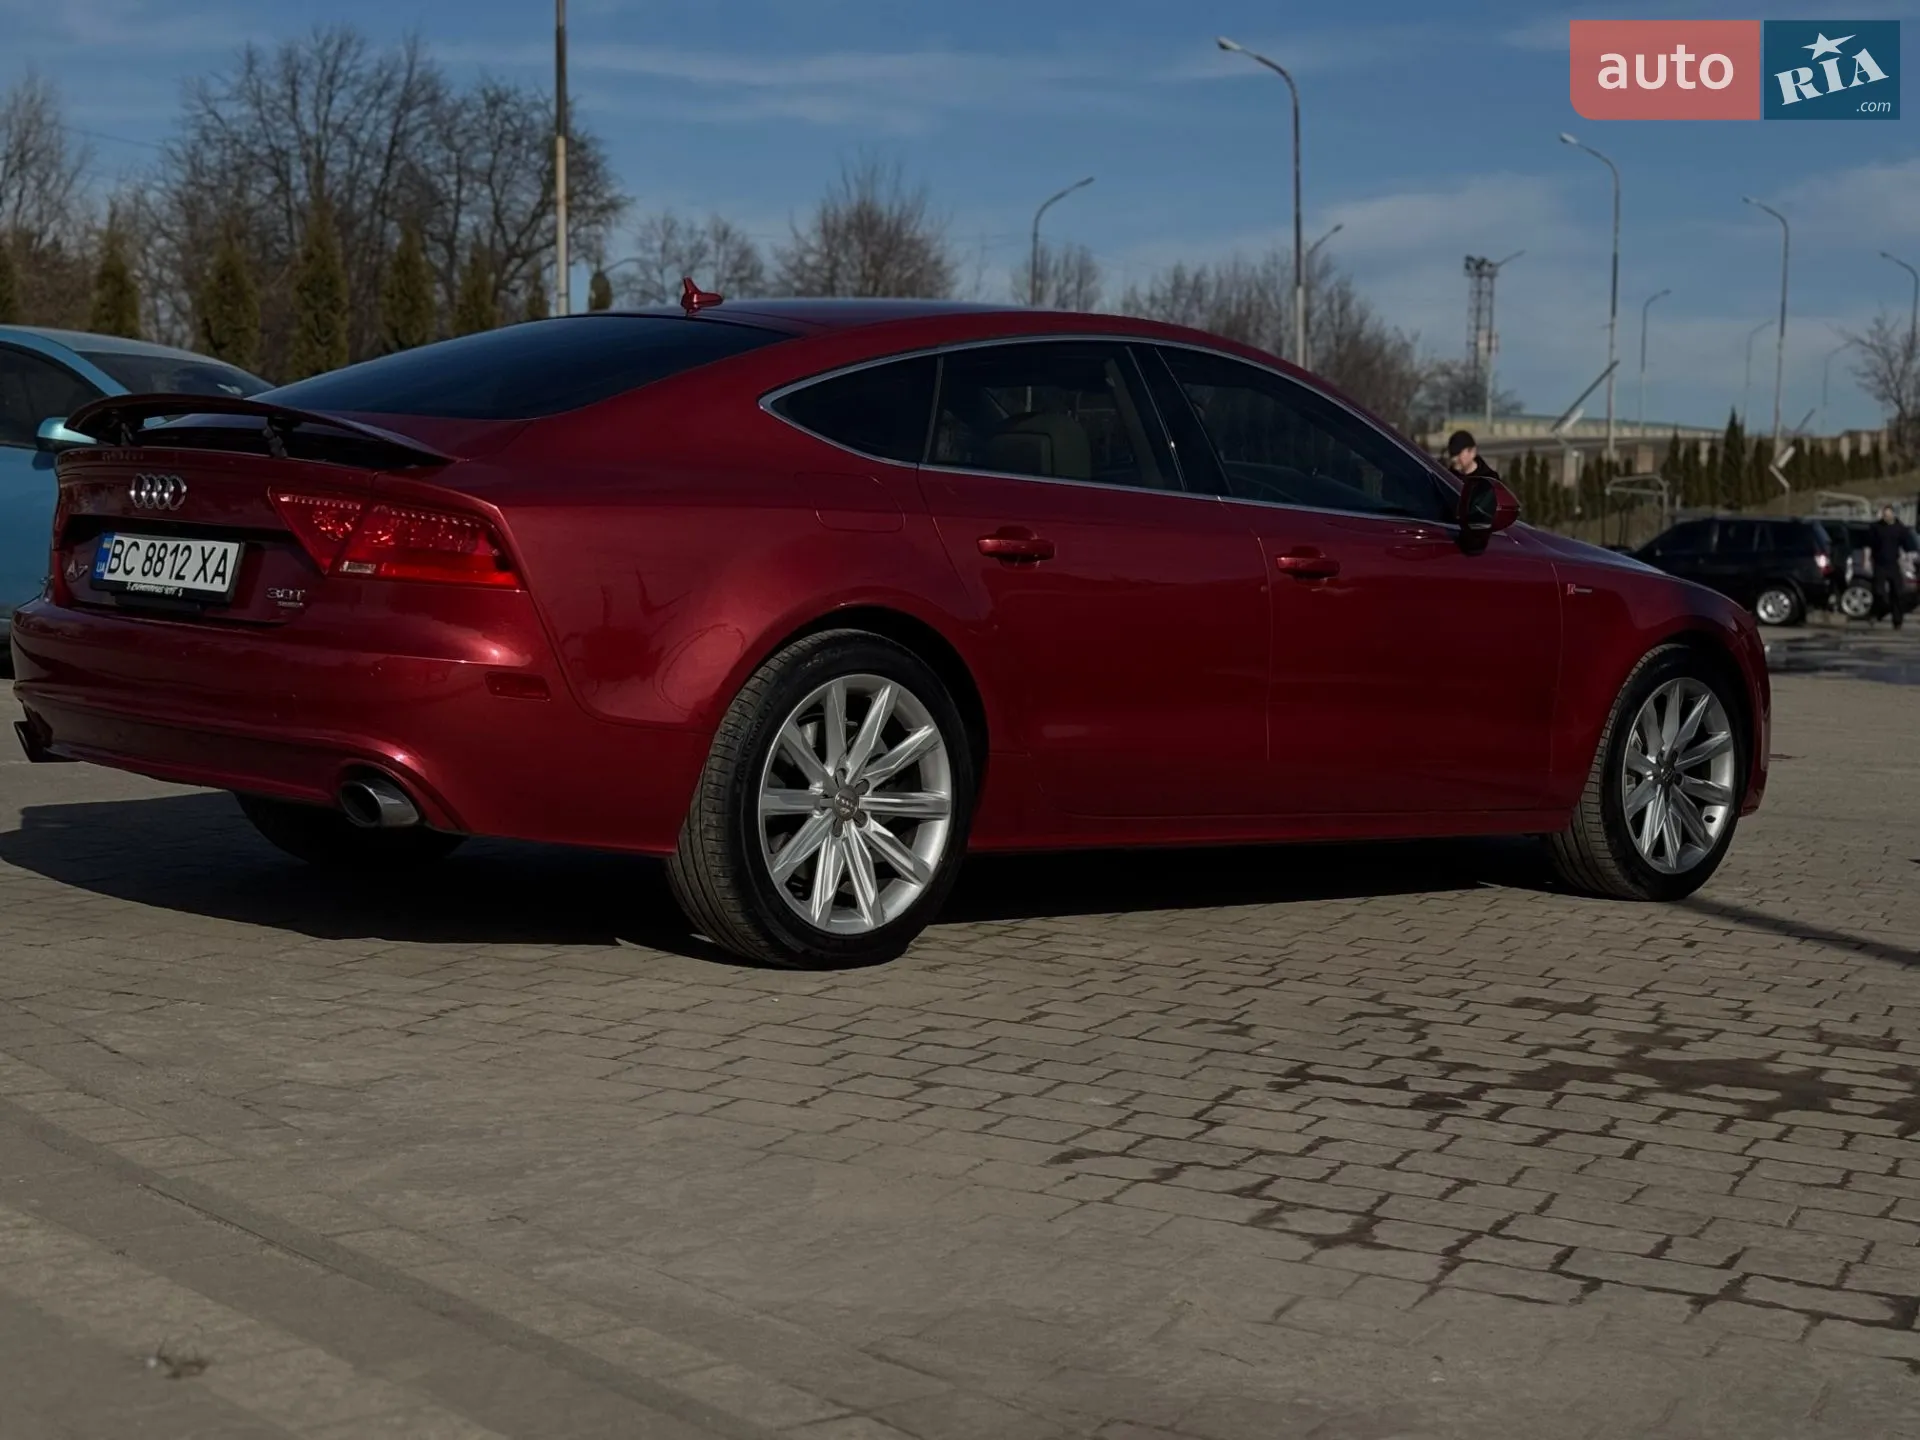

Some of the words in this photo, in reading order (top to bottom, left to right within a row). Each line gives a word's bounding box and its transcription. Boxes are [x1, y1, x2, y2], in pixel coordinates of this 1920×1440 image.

[65, 559, 88, 578] A7
[108, 540, 140, 575] BC
[141, 542, 192, 581] 8812
[192, 545, 229, 585] XA
